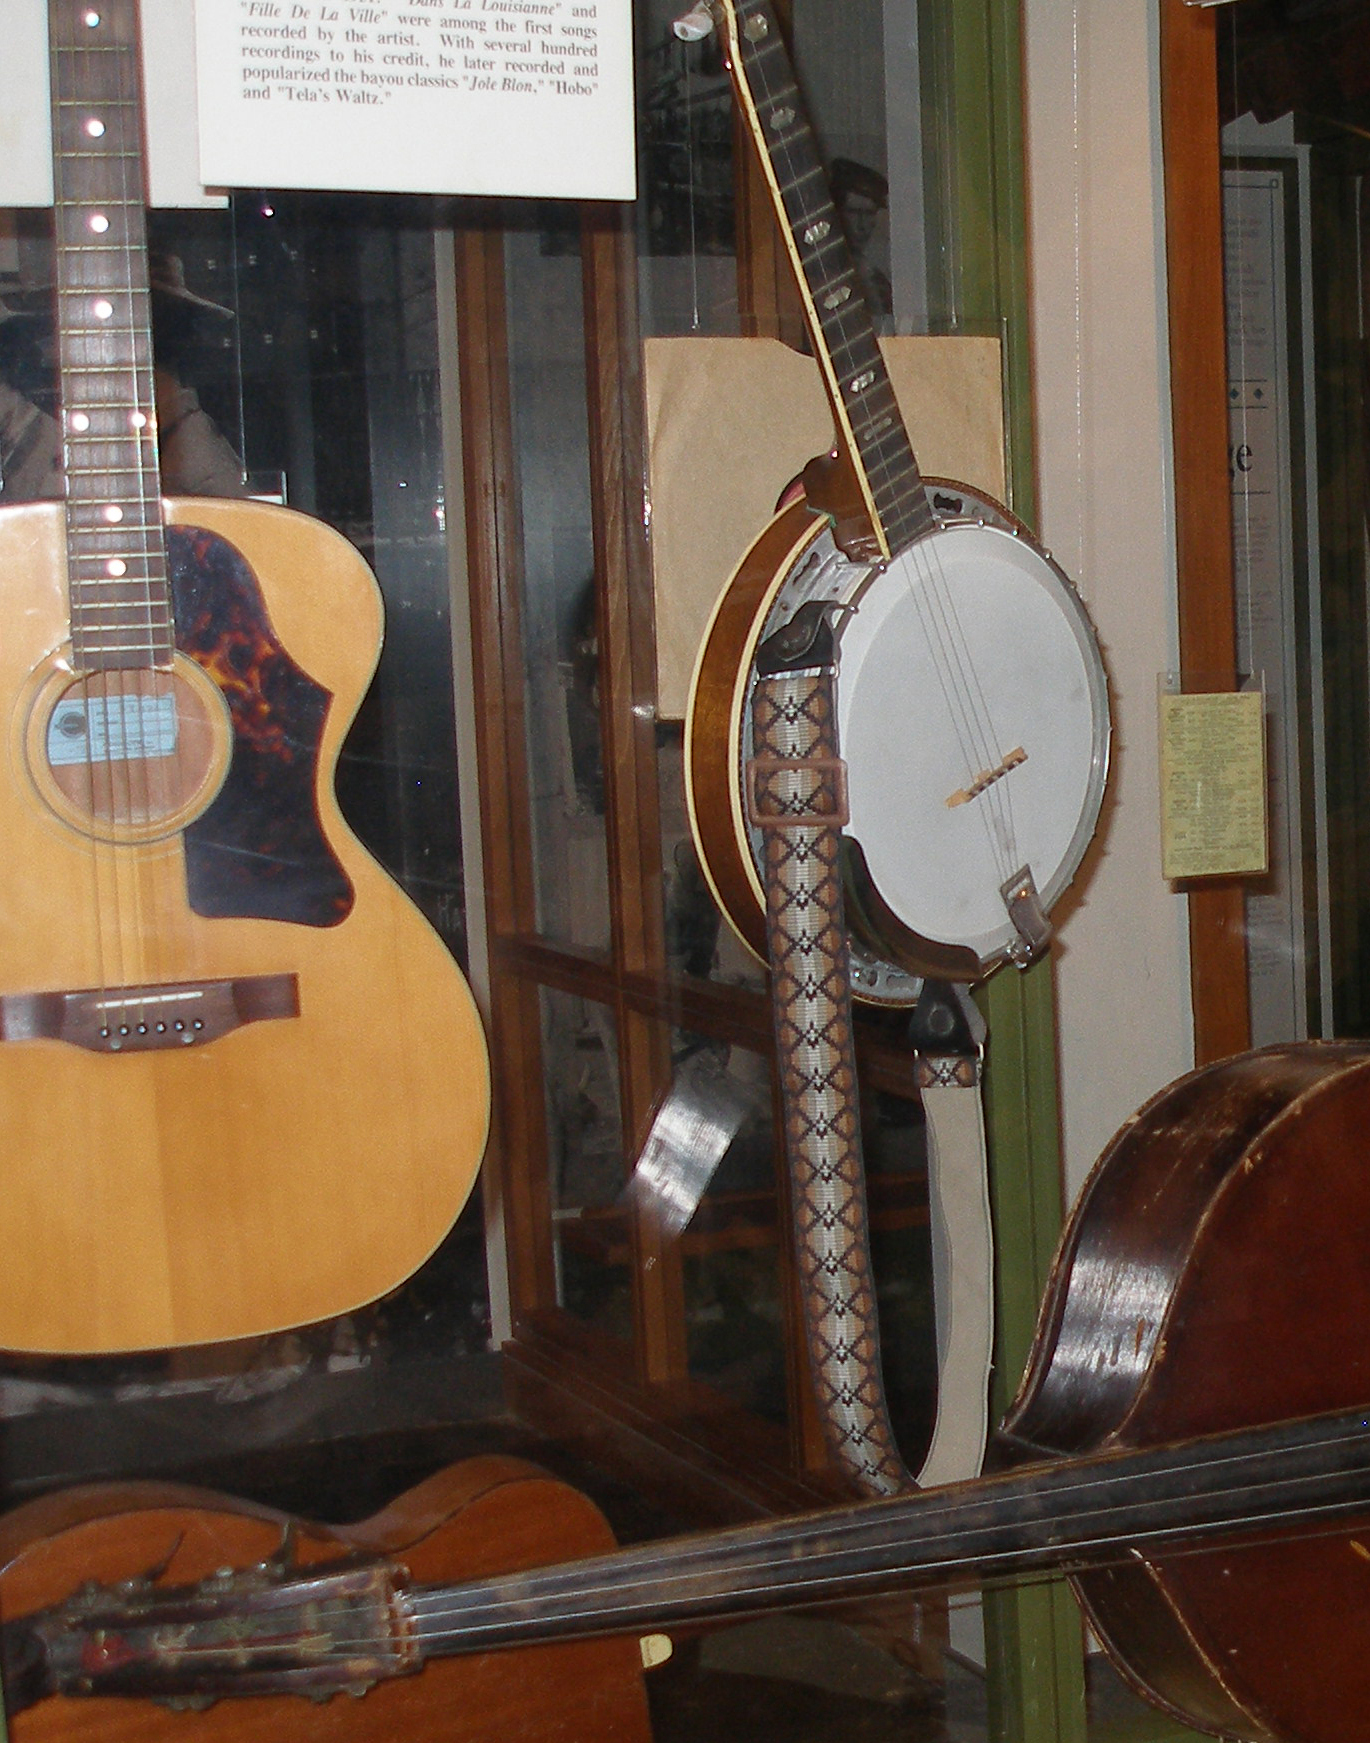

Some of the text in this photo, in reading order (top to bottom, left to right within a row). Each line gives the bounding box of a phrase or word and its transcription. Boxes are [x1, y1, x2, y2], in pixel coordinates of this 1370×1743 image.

[240, 1, 598, 40] "Fille De La Ville" were among the first songs
[572, 5, 598, 18] and
[241, 25, 598, 57] recorded by the artist. With several hundred
[241, 45, 599, 77] recordings to his credit, he later recorded and
[242, 65, 331, 83] popularized
[334, 69, 357, 84] the
[361, 70, 404, 88] bayou
[407, 72, 459, 89] classics
[463, 75, 498, 92] "Jole
[550, 80, 599, 96] "Hobo"
[243, 86, 392, 105] and "Tela's Waltz."
